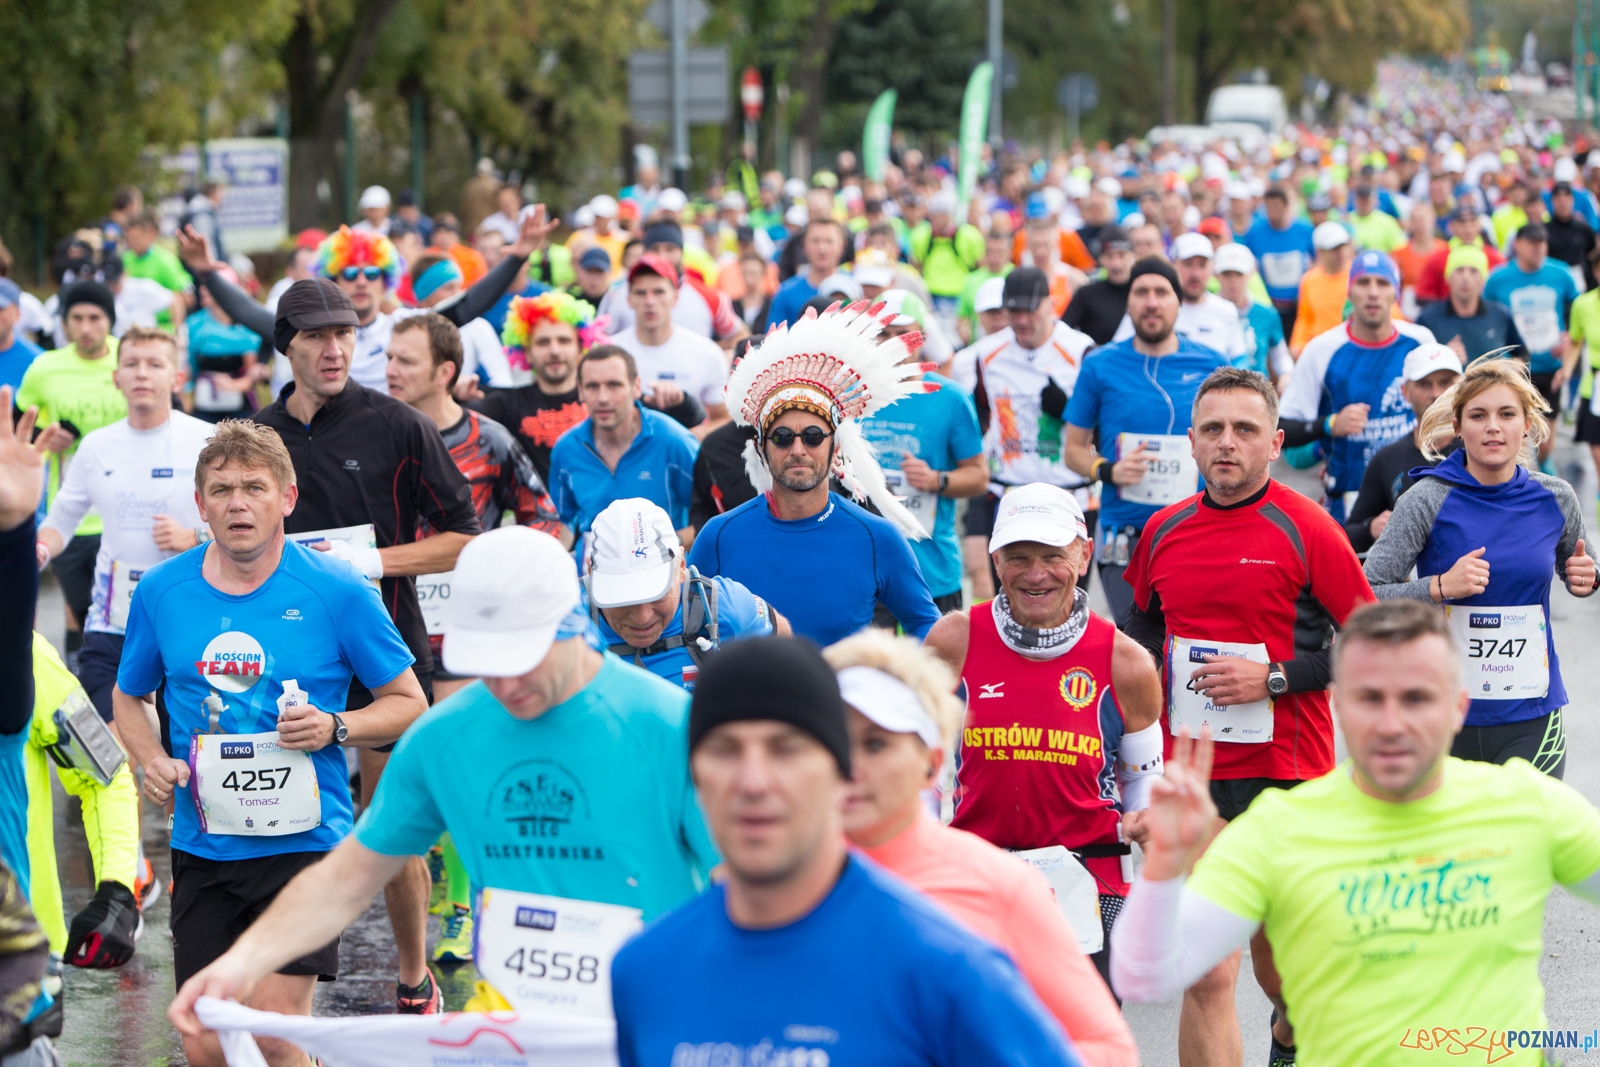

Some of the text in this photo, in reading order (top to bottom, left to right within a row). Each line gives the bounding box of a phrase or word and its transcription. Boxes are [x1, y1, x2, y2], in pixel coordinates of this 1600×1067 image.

[1469, 638, 1527, 658] 3747
[215, 651, 261, 662] KOŚCIAN
[195, 661, 260, 676] TEAM
[1481, 664, 1514, 673] Magda
[1204, 702, 1228, 712] Artur
[964, 723, 1101, 758] OSTRÓW WLKP.
[985, 750, 1078, 766] K.S. MARATON
[222, 767, 292, 792] 4257
[237, 798, 280, 807] Tomasz
[1338, 860, 1492, 917] Winter
[504, 947, 599, 984] 4558
